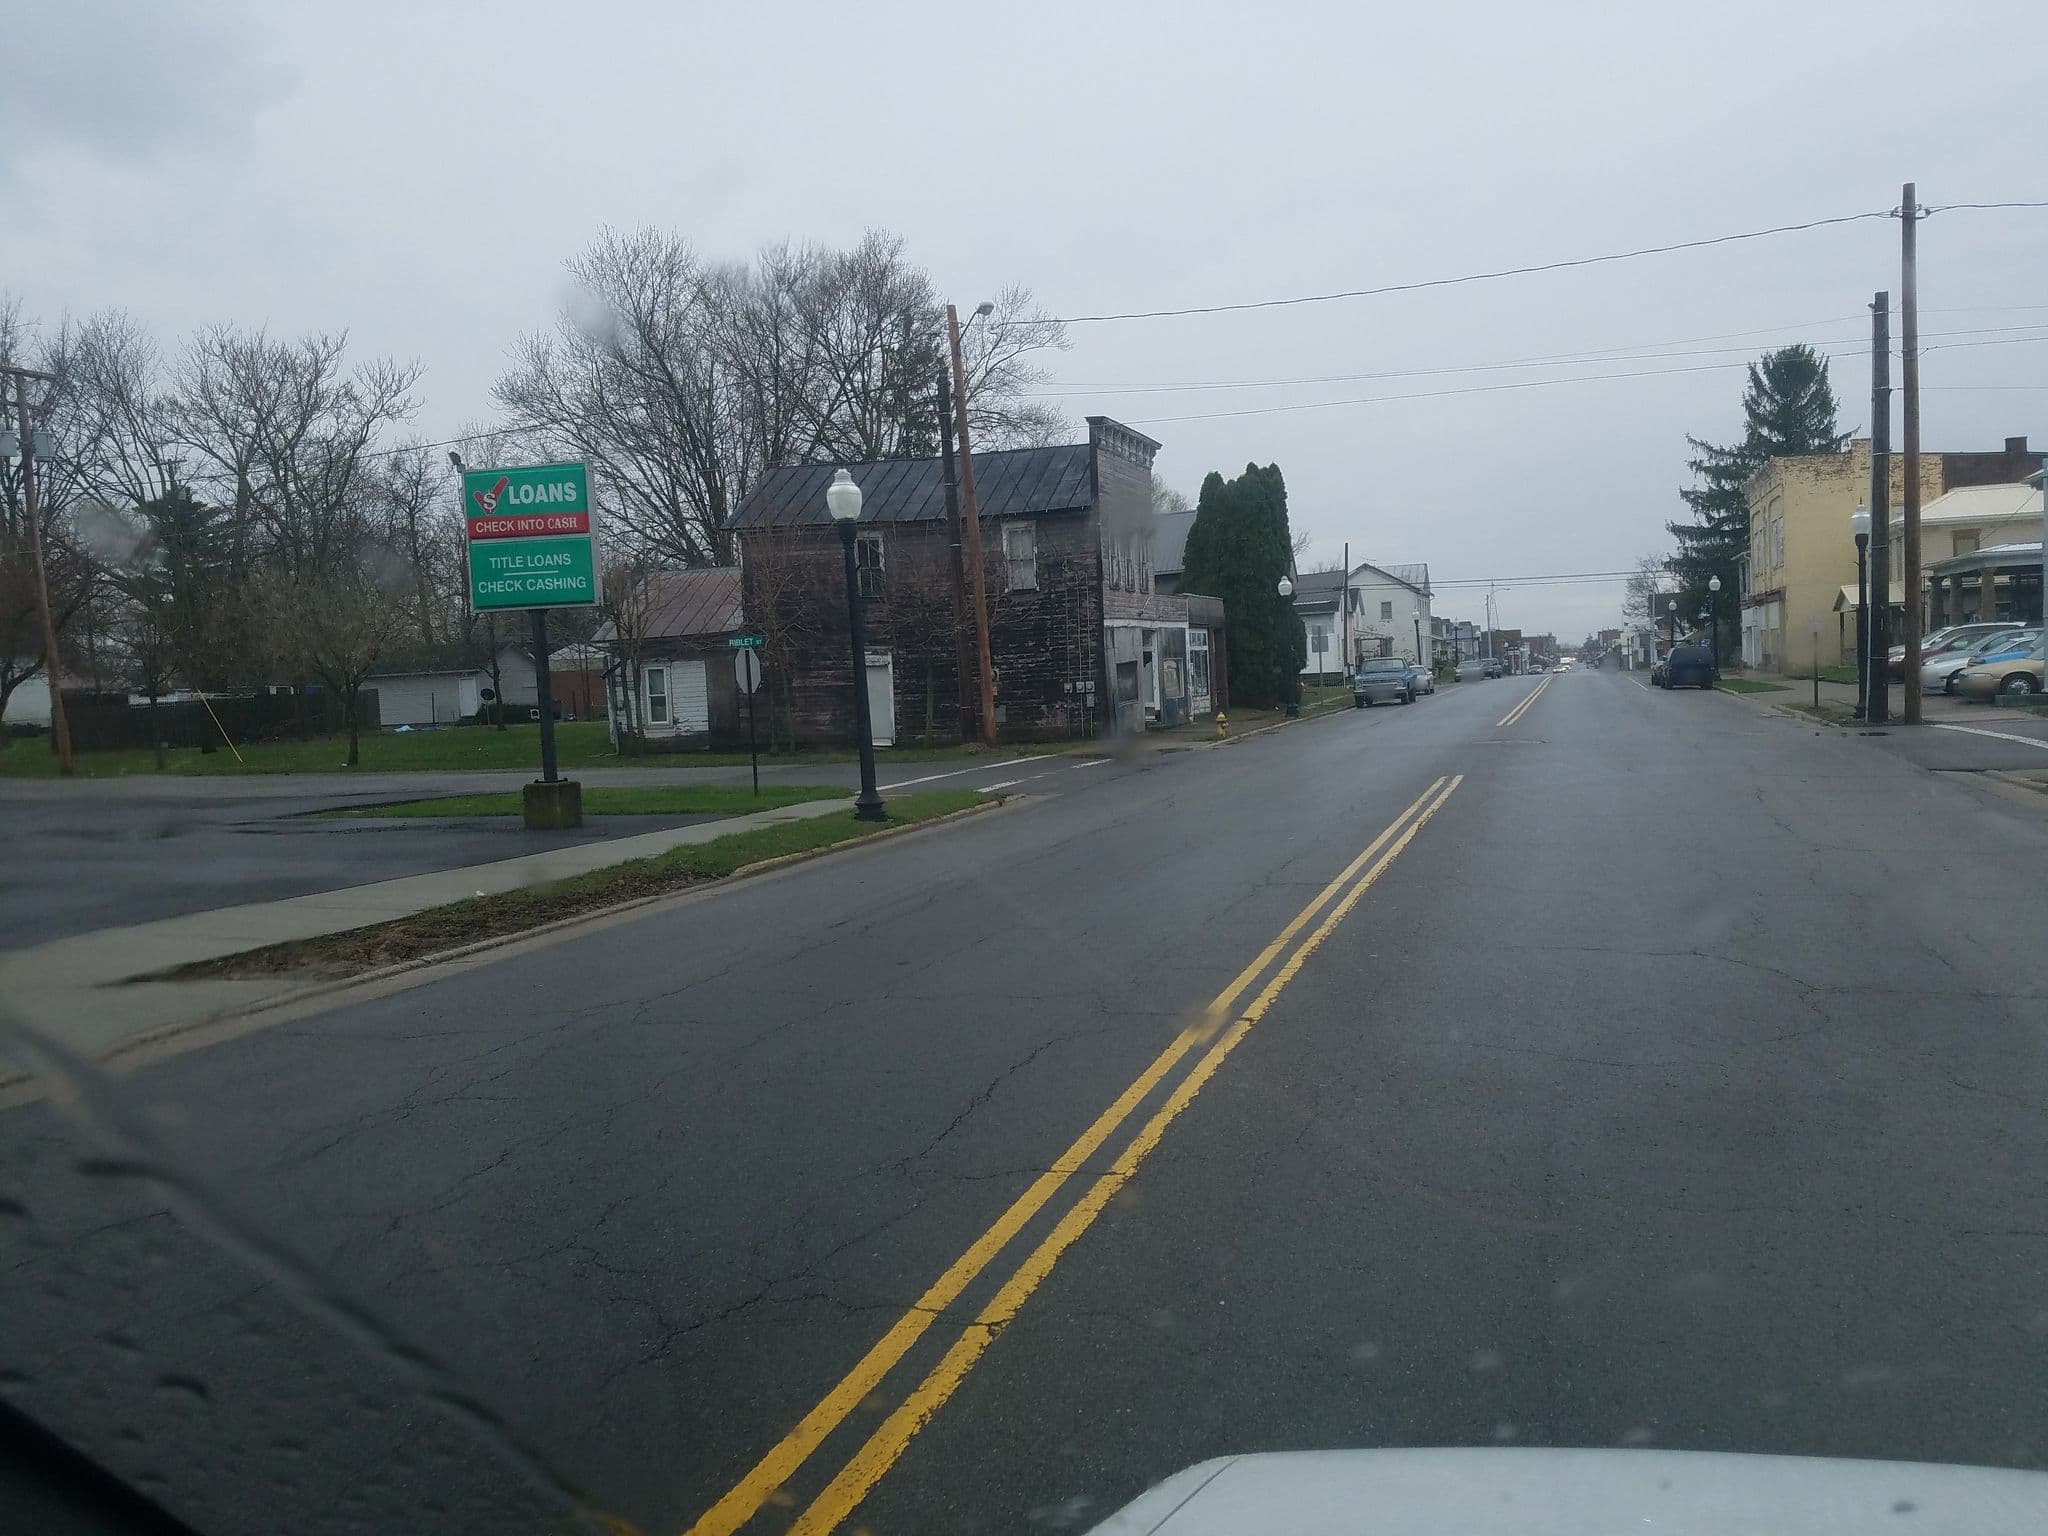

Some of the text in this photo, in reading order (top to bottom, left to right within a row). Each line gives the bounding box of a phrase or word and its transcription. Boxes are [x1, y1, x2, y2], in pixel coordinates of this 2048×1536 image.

[508, 482, 577, 505] LOANS
[475, 517, 577, 533] CHECK INTO CASH
[489, 553, 572, 568] TITLE LOANS
[478, 576, 587, 593] CHECK CASHING
